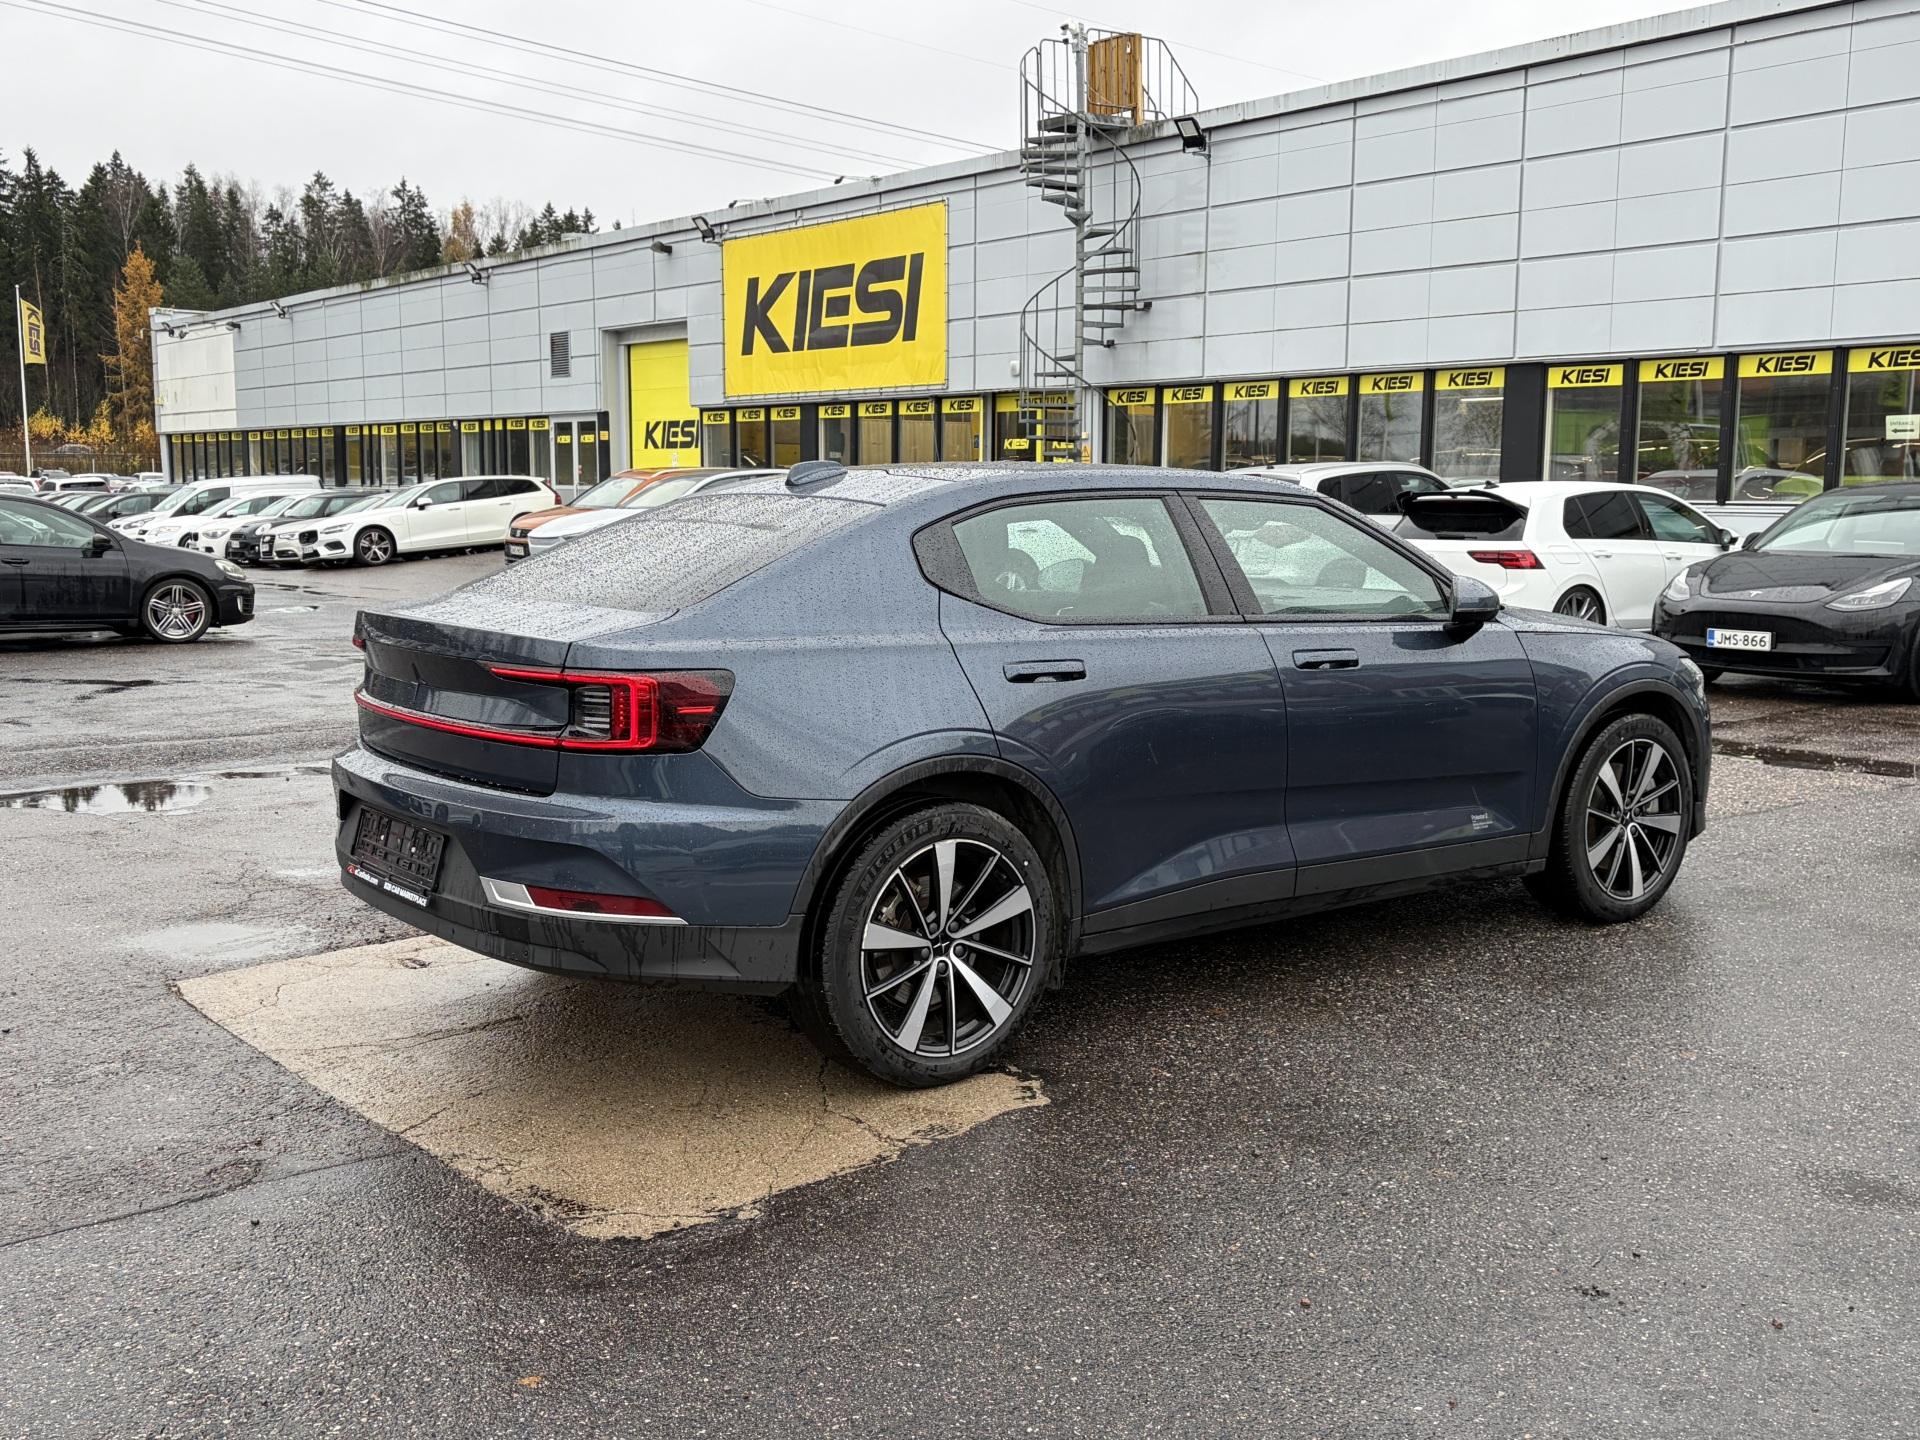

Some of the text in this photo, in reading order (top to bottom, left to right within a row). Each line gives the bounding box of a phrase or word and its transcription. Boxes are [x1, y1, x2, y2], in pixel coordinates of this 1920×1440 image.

[741, 252, 925, 356] KIESI
[26, 307, 41, 357] KIESI
[1756, 354, 1816, 373] KIESI
[1868, 350, 1920, 368] KIES
[1561, 368, 1611, 384] KIESI
[1655, 361, 1709, 379] KIESI
[1372, 375, 1413, 391] KIESI
[1447, 371, 1493, 387] KIESI
[1171, 387, 1204, 401] KIESI
[1234, 384, 1269, 399] KIESI
[1300, 380, 1340, 395] KIESI
[1116, 390, 1148, 404] KIESI
[824, 405, 846, 416] KIESI
[865, 403, 887, 414] KIESI
[906, 401, 929, 413] KIESI
[950, 400, 974, 411] KIESI
[706, 413, 726, 422] KIESI
[742, 410, 761, 420] KIESI
[776, 408, 797, 419] KIESI
[644, 419, 700, 450] KIESI
[1004, 439, 1030, 450] KIESI
[1716, 632, 1767, 648] JMS-866
